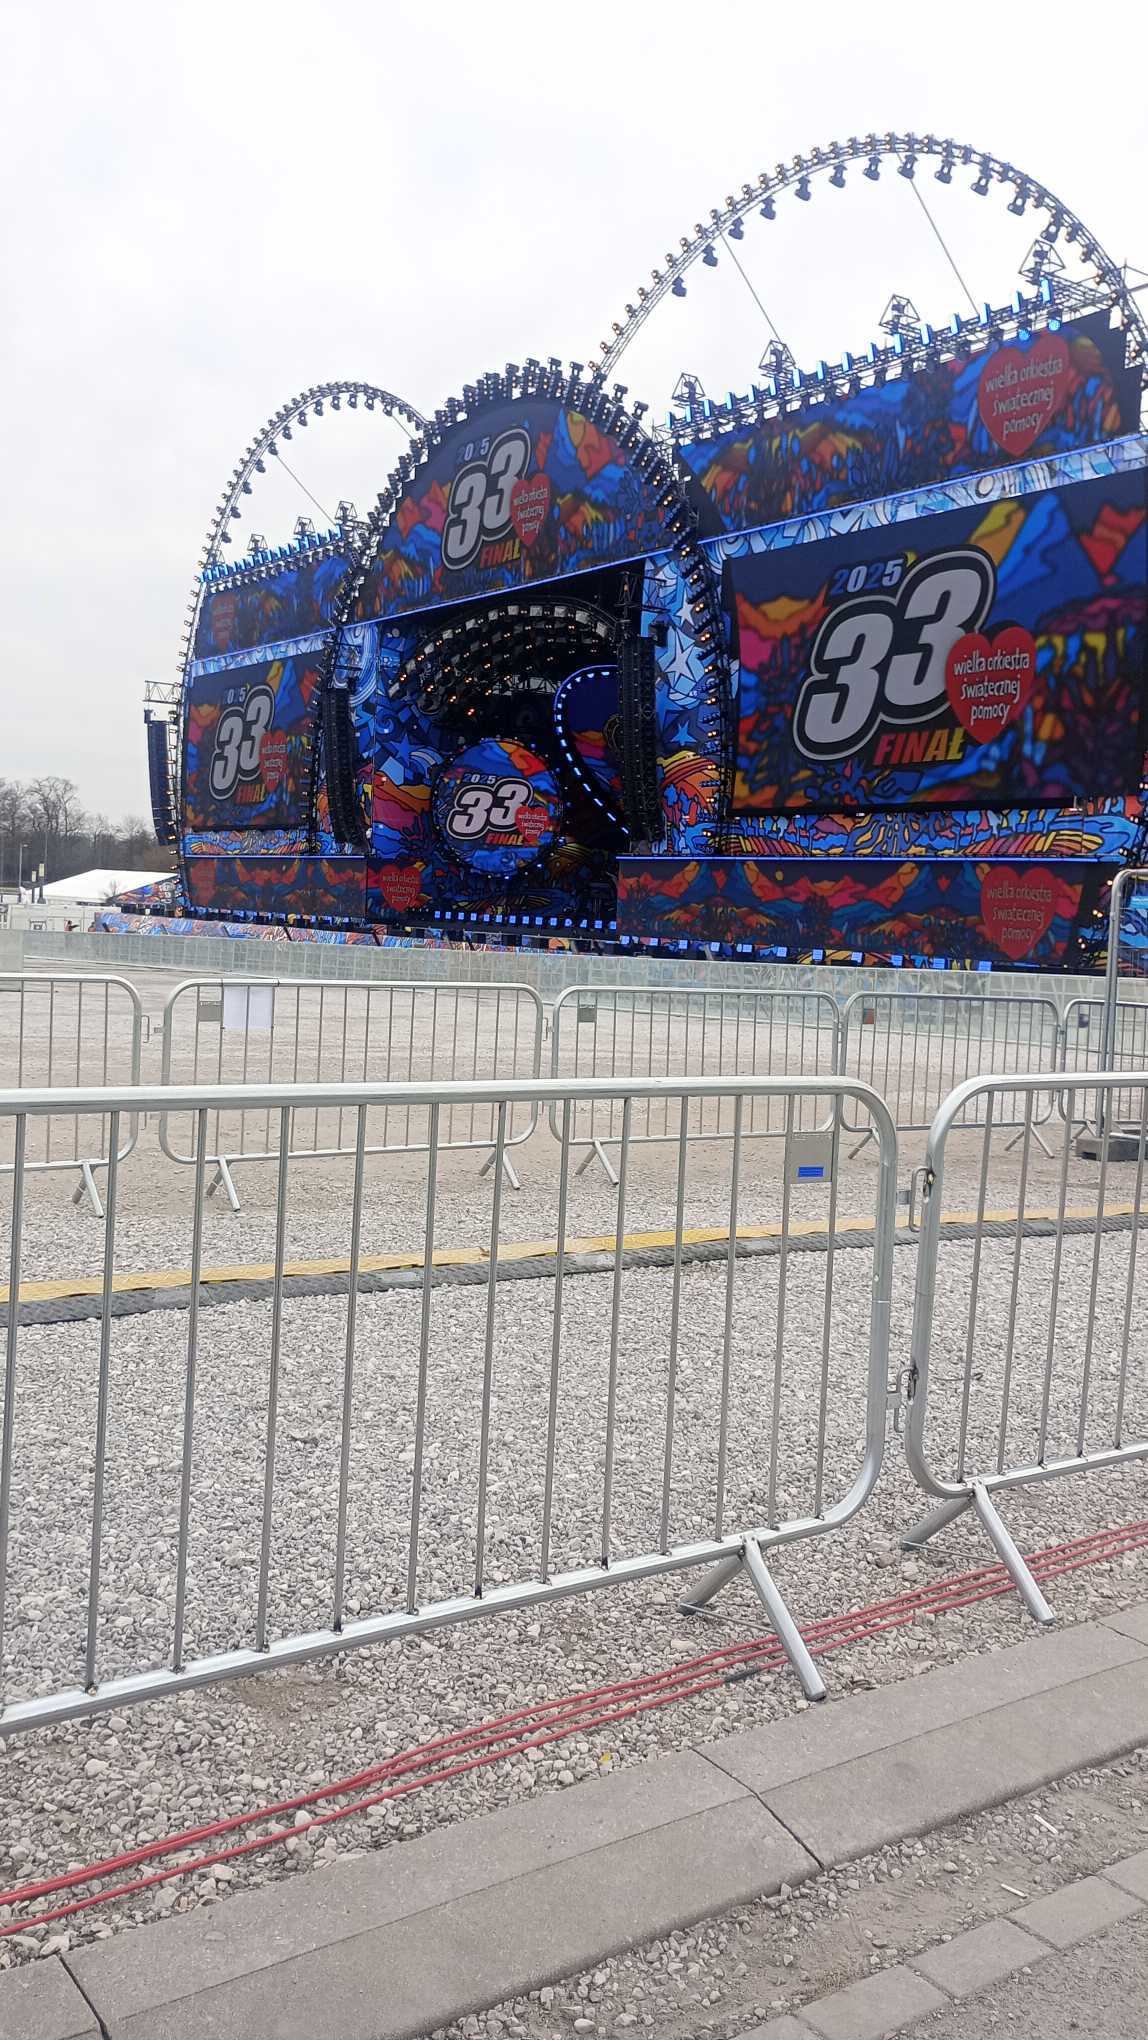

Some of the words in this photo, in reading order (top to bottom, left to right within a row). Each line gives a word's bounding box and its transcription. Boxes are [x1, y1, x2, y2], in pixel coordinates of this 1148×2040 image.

[446, 439, 526, 559] 33
[831, 559, 904, 594] 2025
[803, 567, 983, 745] 33
[953, 649, 986, 676] wielka
[987, 647, 1030, 671] orkiestra
[970, 702, 1011, 726] pomocy
[213, 695, 272, 790] 33
[464, 773, 498, 785] 2025
[452, 783, 529, 834] 33
